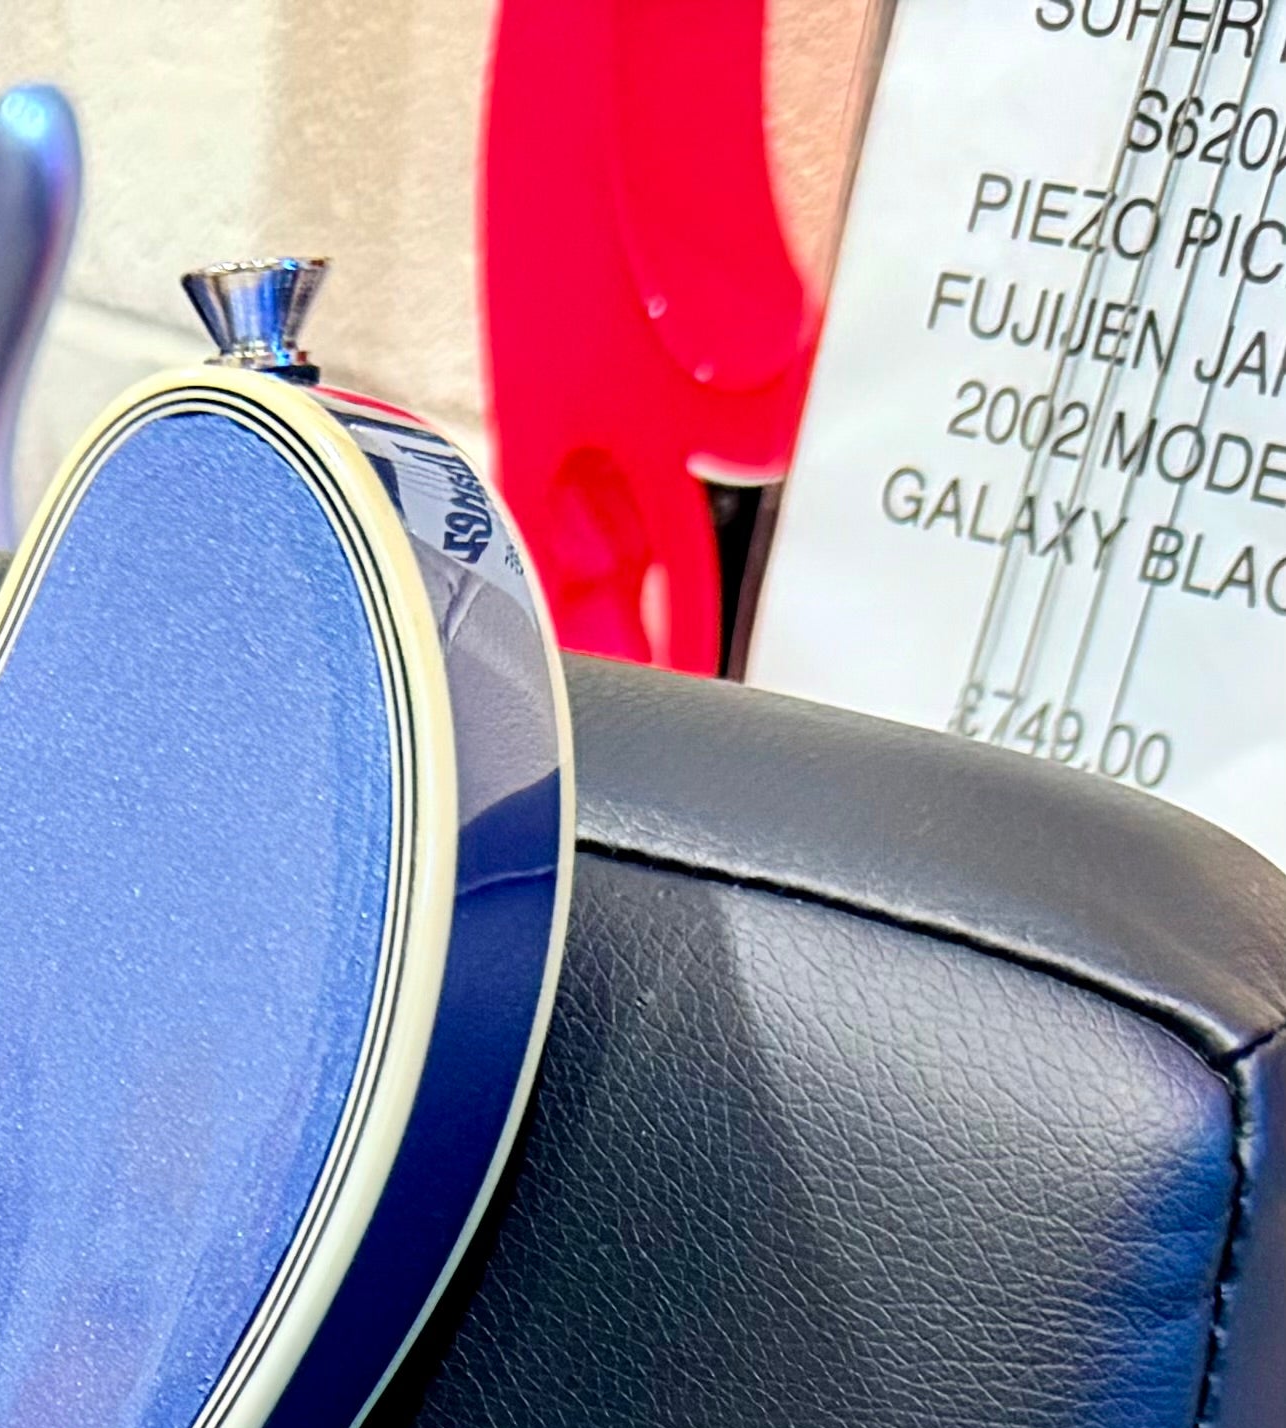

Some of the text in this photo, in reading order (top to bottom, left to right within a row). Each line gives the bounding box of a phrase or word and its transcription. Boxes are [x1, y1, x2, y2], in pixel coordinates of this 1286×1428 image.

[1126, 89, 1286, 172] S620
[967, 172, 1286, 284] PIEZO PIC
[926, 270, 1169, 377] FUJIJEN
[946, 379, 1091, 460] 2002
[881, 466, 1130, 571] GALAXY
[956, 681, 1173, 788] £749.00
